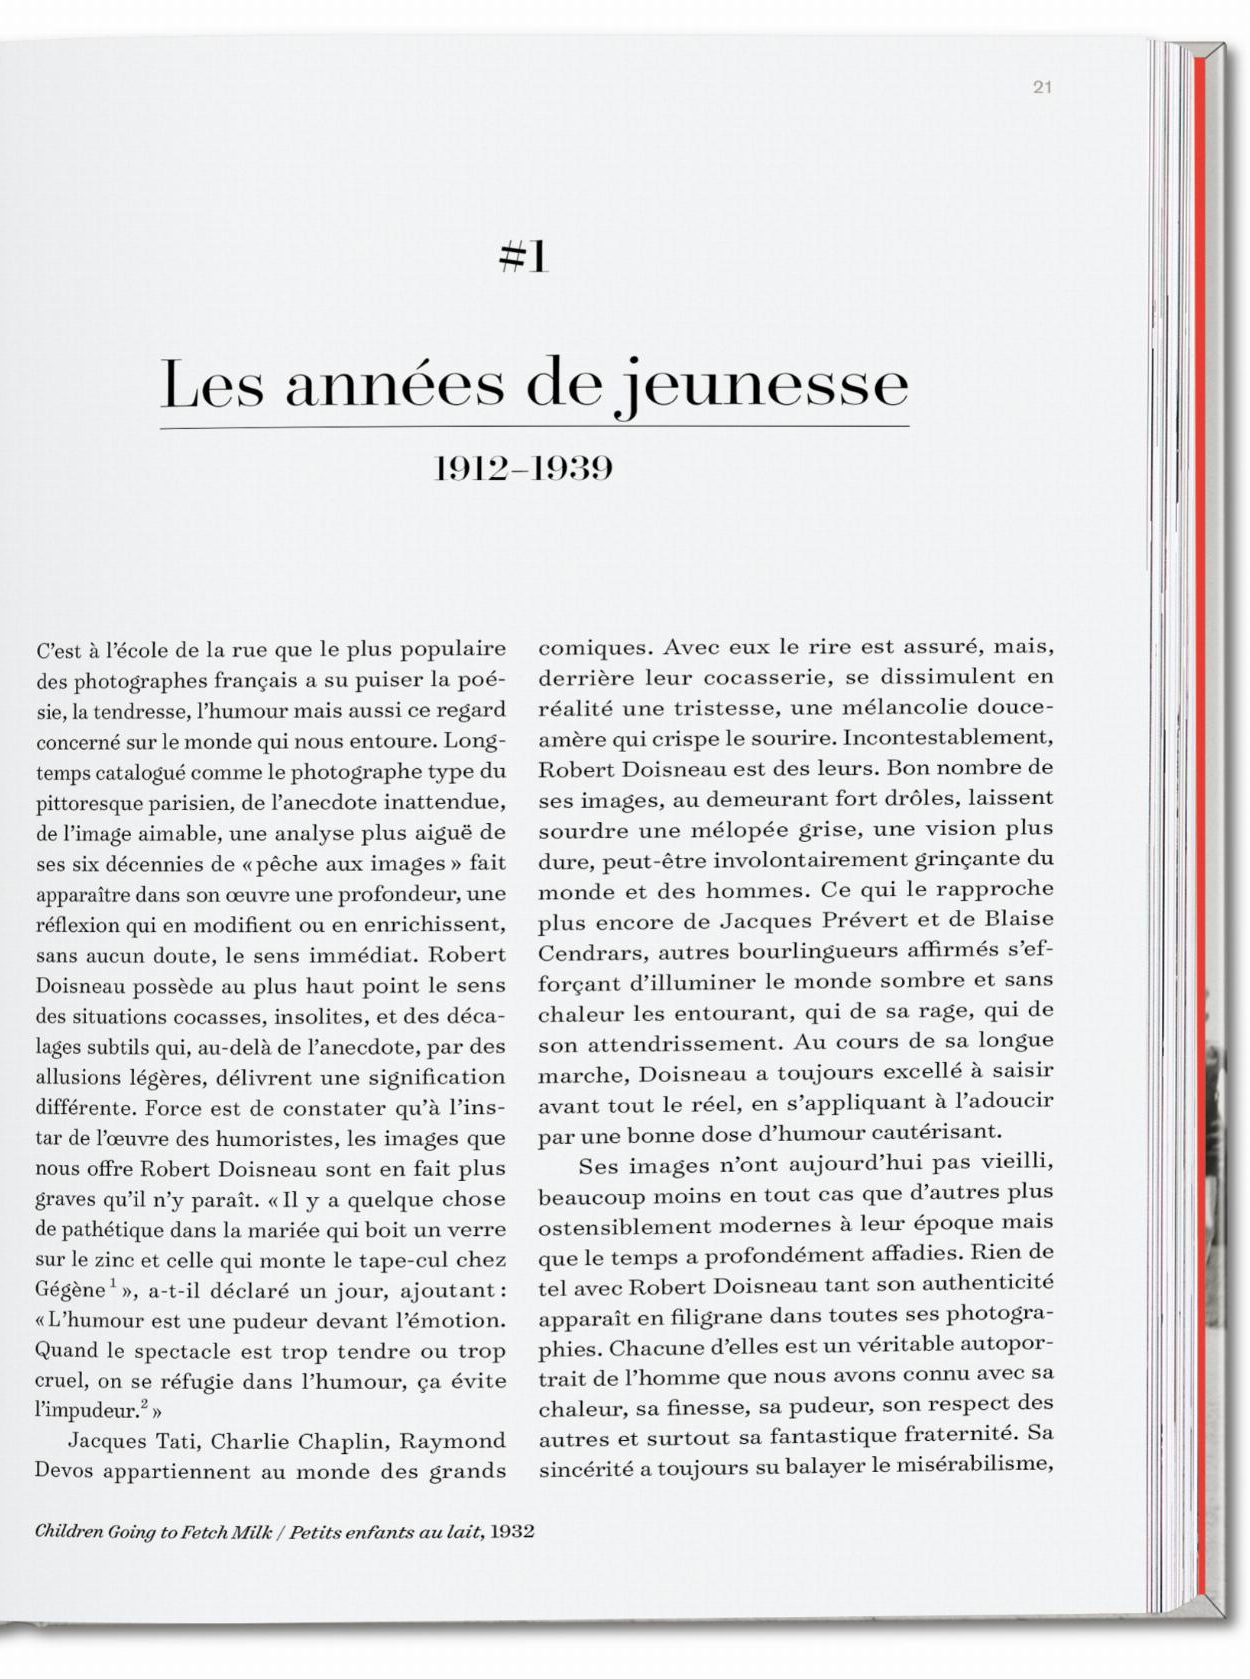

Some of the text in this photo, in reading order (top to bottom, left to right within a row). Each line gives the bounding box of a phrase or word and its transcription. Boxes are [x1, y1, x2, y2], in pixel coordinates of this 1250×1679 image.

[1033, 79, 1051, 94] 21
[498, 239, 550, 273] #1
[160, 353, 909, 423] Les années de jeunesse
[36, 638, 506, 663] C’est à l’école de la rue que le plus populaire
[538, 637, 1054, 661] comiques. Avec eux le rire est assuré, mais,
[36, 731, 506, 755] concerné sur le monde qui nous entoure. Long-
[538, 727, 1053, 753] amère qui crispe le sourire. Incontestablement,
[36, 822, 506, 848] de l’image aimable, une analyse plus aiguë de
[539, 818, 1054, 844] sourdre une mélopée grise, une vision plus
[36, 914, 506, 939] réflexion qui en modifient ou en enrichissent,
[539, 970, 1054, 996] forçant d’illuminer le monde sombre et sans
[35, 1006, 505, 1028] des situations cocasses, insolites, et des déca-
[538, 1060, 1054, 1086] marche, Doisneau a toujours excellé à saisir
[35, 1097, 505, 1121] différente. Force est de constater qu’à l’ins-
[36, 1158, 506, 1182] nous offre Robert Doisneau sont en fait plus
[579, 1150, 1053, 1179] Ses images n’ont aujourd’hui pas vieilli,
[539, 1303, 1054, 1333] apparaît en filigrane dans toutes ses photogra-
[34, 1370, 507, 1395] cruel, on se réfugie dans l’humour, ça évite
[34, 1460, 507, 1485] Devos appartiennent au monde des grands
[539, 1453, 1054, 1481] sincérité a toujours su balayer le misérabilisme,
[35, 1522, 103, 1539] Children
[108, 1524, 157, 1543] Going
[160, 1526, 178, 1539] to
[181, 1524, 228, 1540] Fetch
[230, 1524, 273, 1540] Milk
[289, 1525, 343, 1540] Petits
[345, 1524, 415, 1540] enfants
[419, 1529, 443, 1539] au
[446, 1524, 485, 1541] lait,
[491, 1524, 535, 1539] 1932
